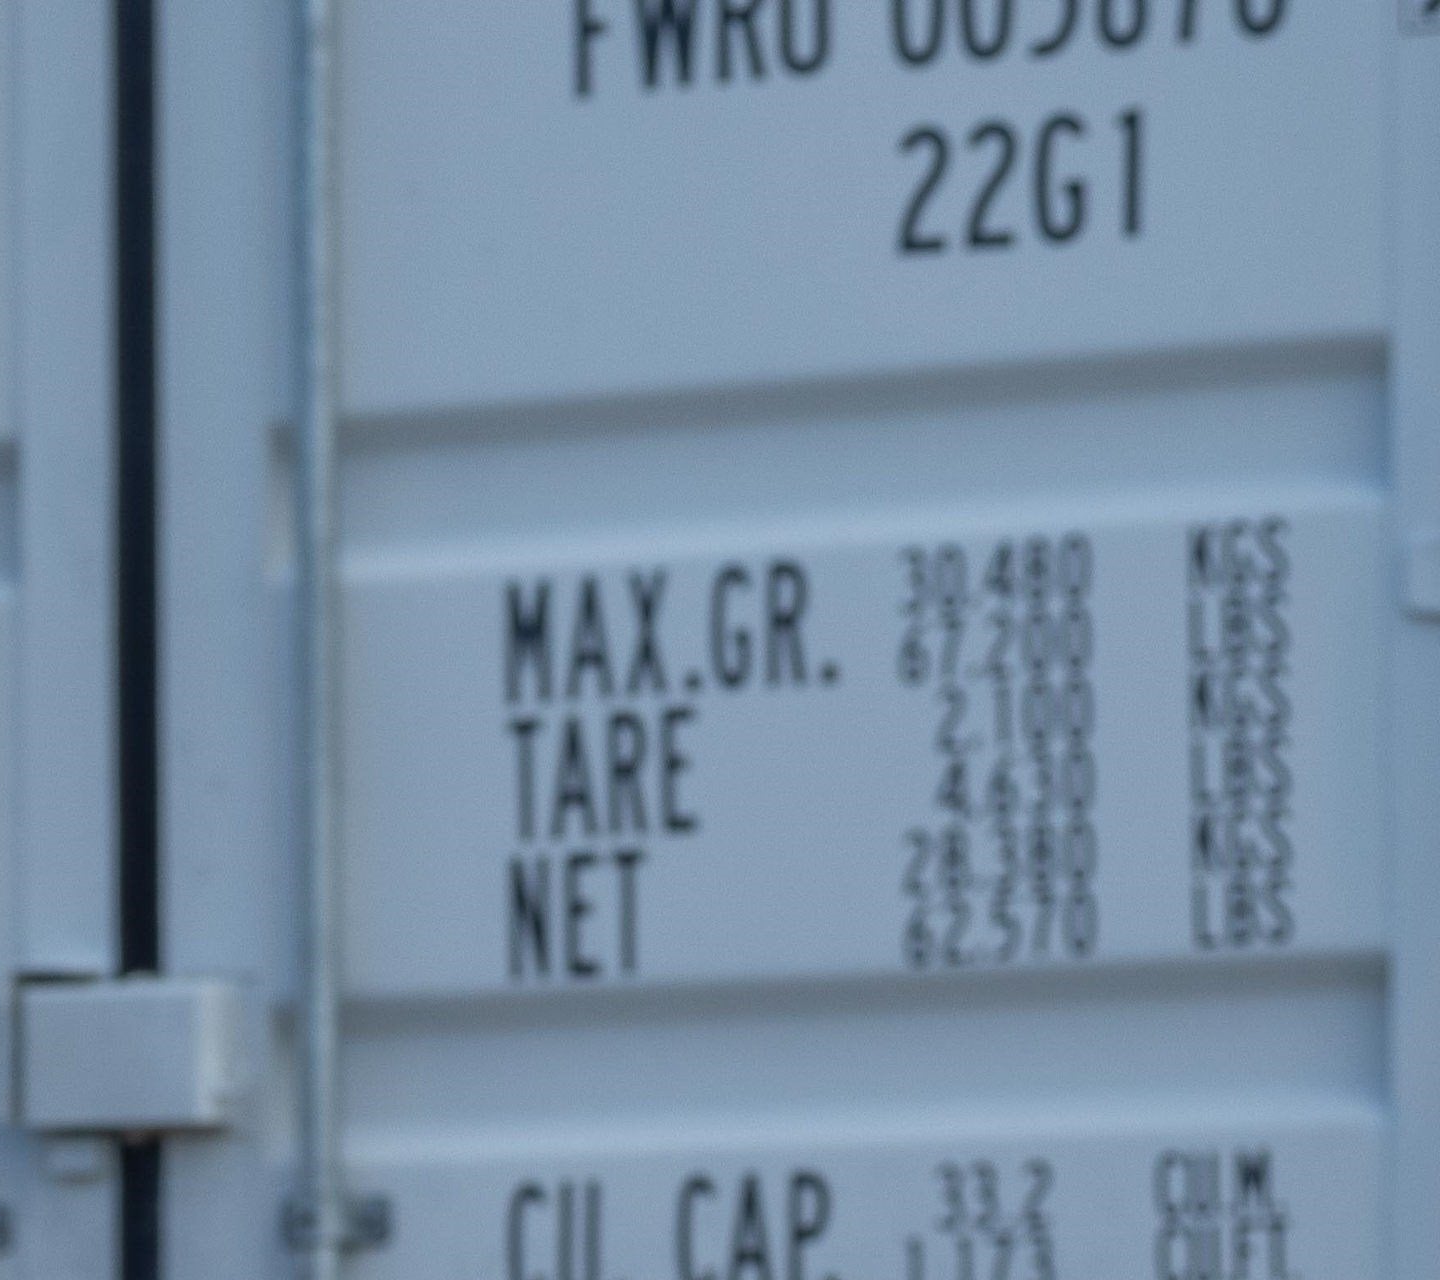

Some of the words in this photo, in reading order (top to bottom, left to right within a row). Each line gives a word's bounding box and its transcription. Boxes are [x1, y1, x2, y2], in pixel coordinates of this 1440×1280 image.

[894, 106, 1146, 258] 22G1
[1187, 516, 1290, 588] KGS
[505, 704, 700, 843] TARE
[1187, 664, 1292, 730] KGS
[506, 849, 648, 980] NET
[1188, 806, 1293, 874] KGS
